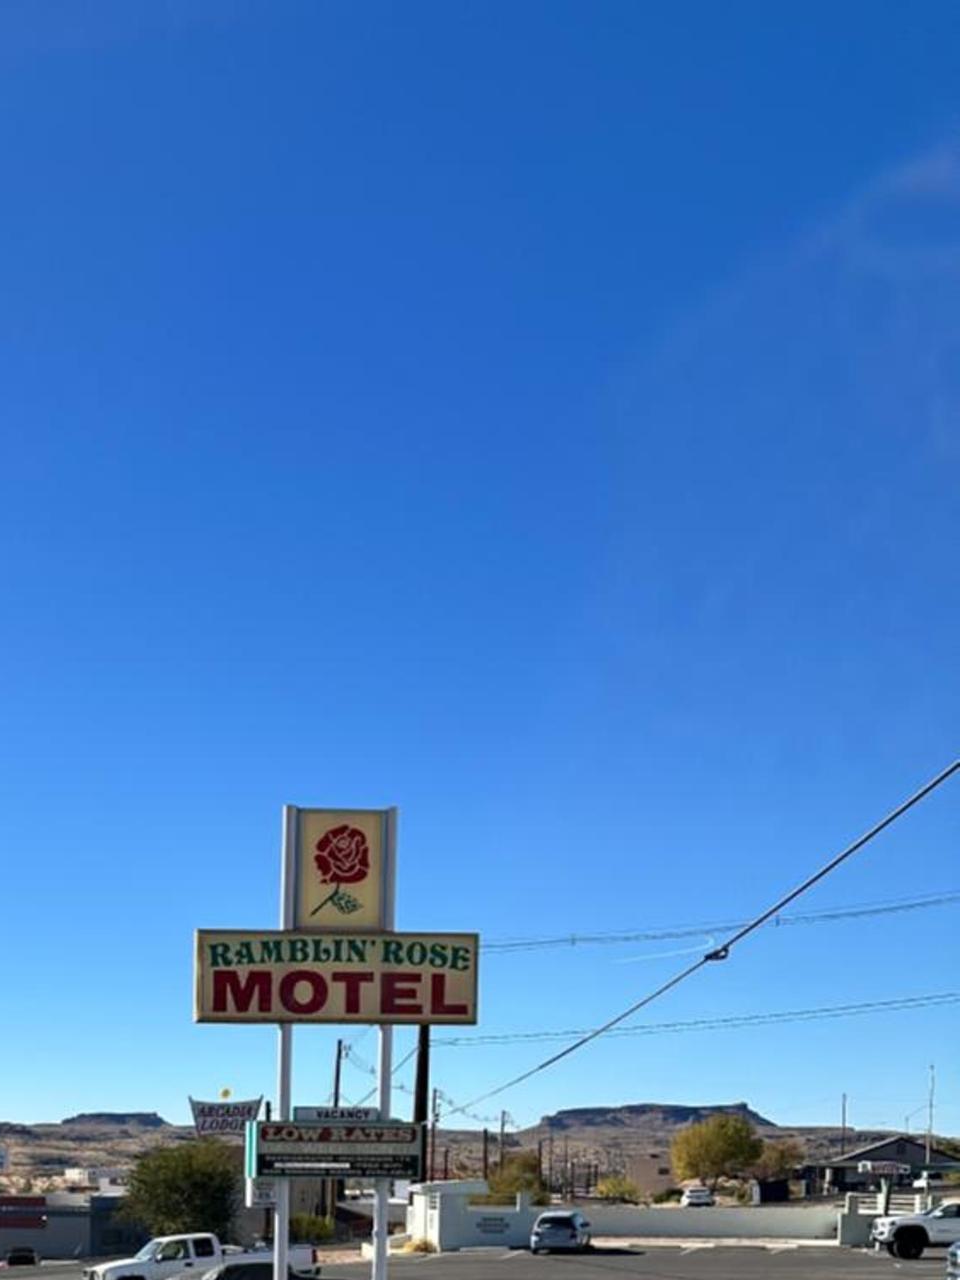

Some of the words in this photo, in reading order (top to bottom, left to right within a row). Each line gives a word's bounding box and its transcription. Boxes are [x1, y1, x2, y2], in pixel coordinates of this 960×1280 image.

[208, 938, 377, 967] RAMBLIN'
[381, 941, 470, 971] ROSE
[212, 970, 469, 1015] MOTEL
[316, 1110, 370, 1120] VACANCY
[266, 1127, 321, 1141] LOW
[330, 1127, 413, 1142] RATES
